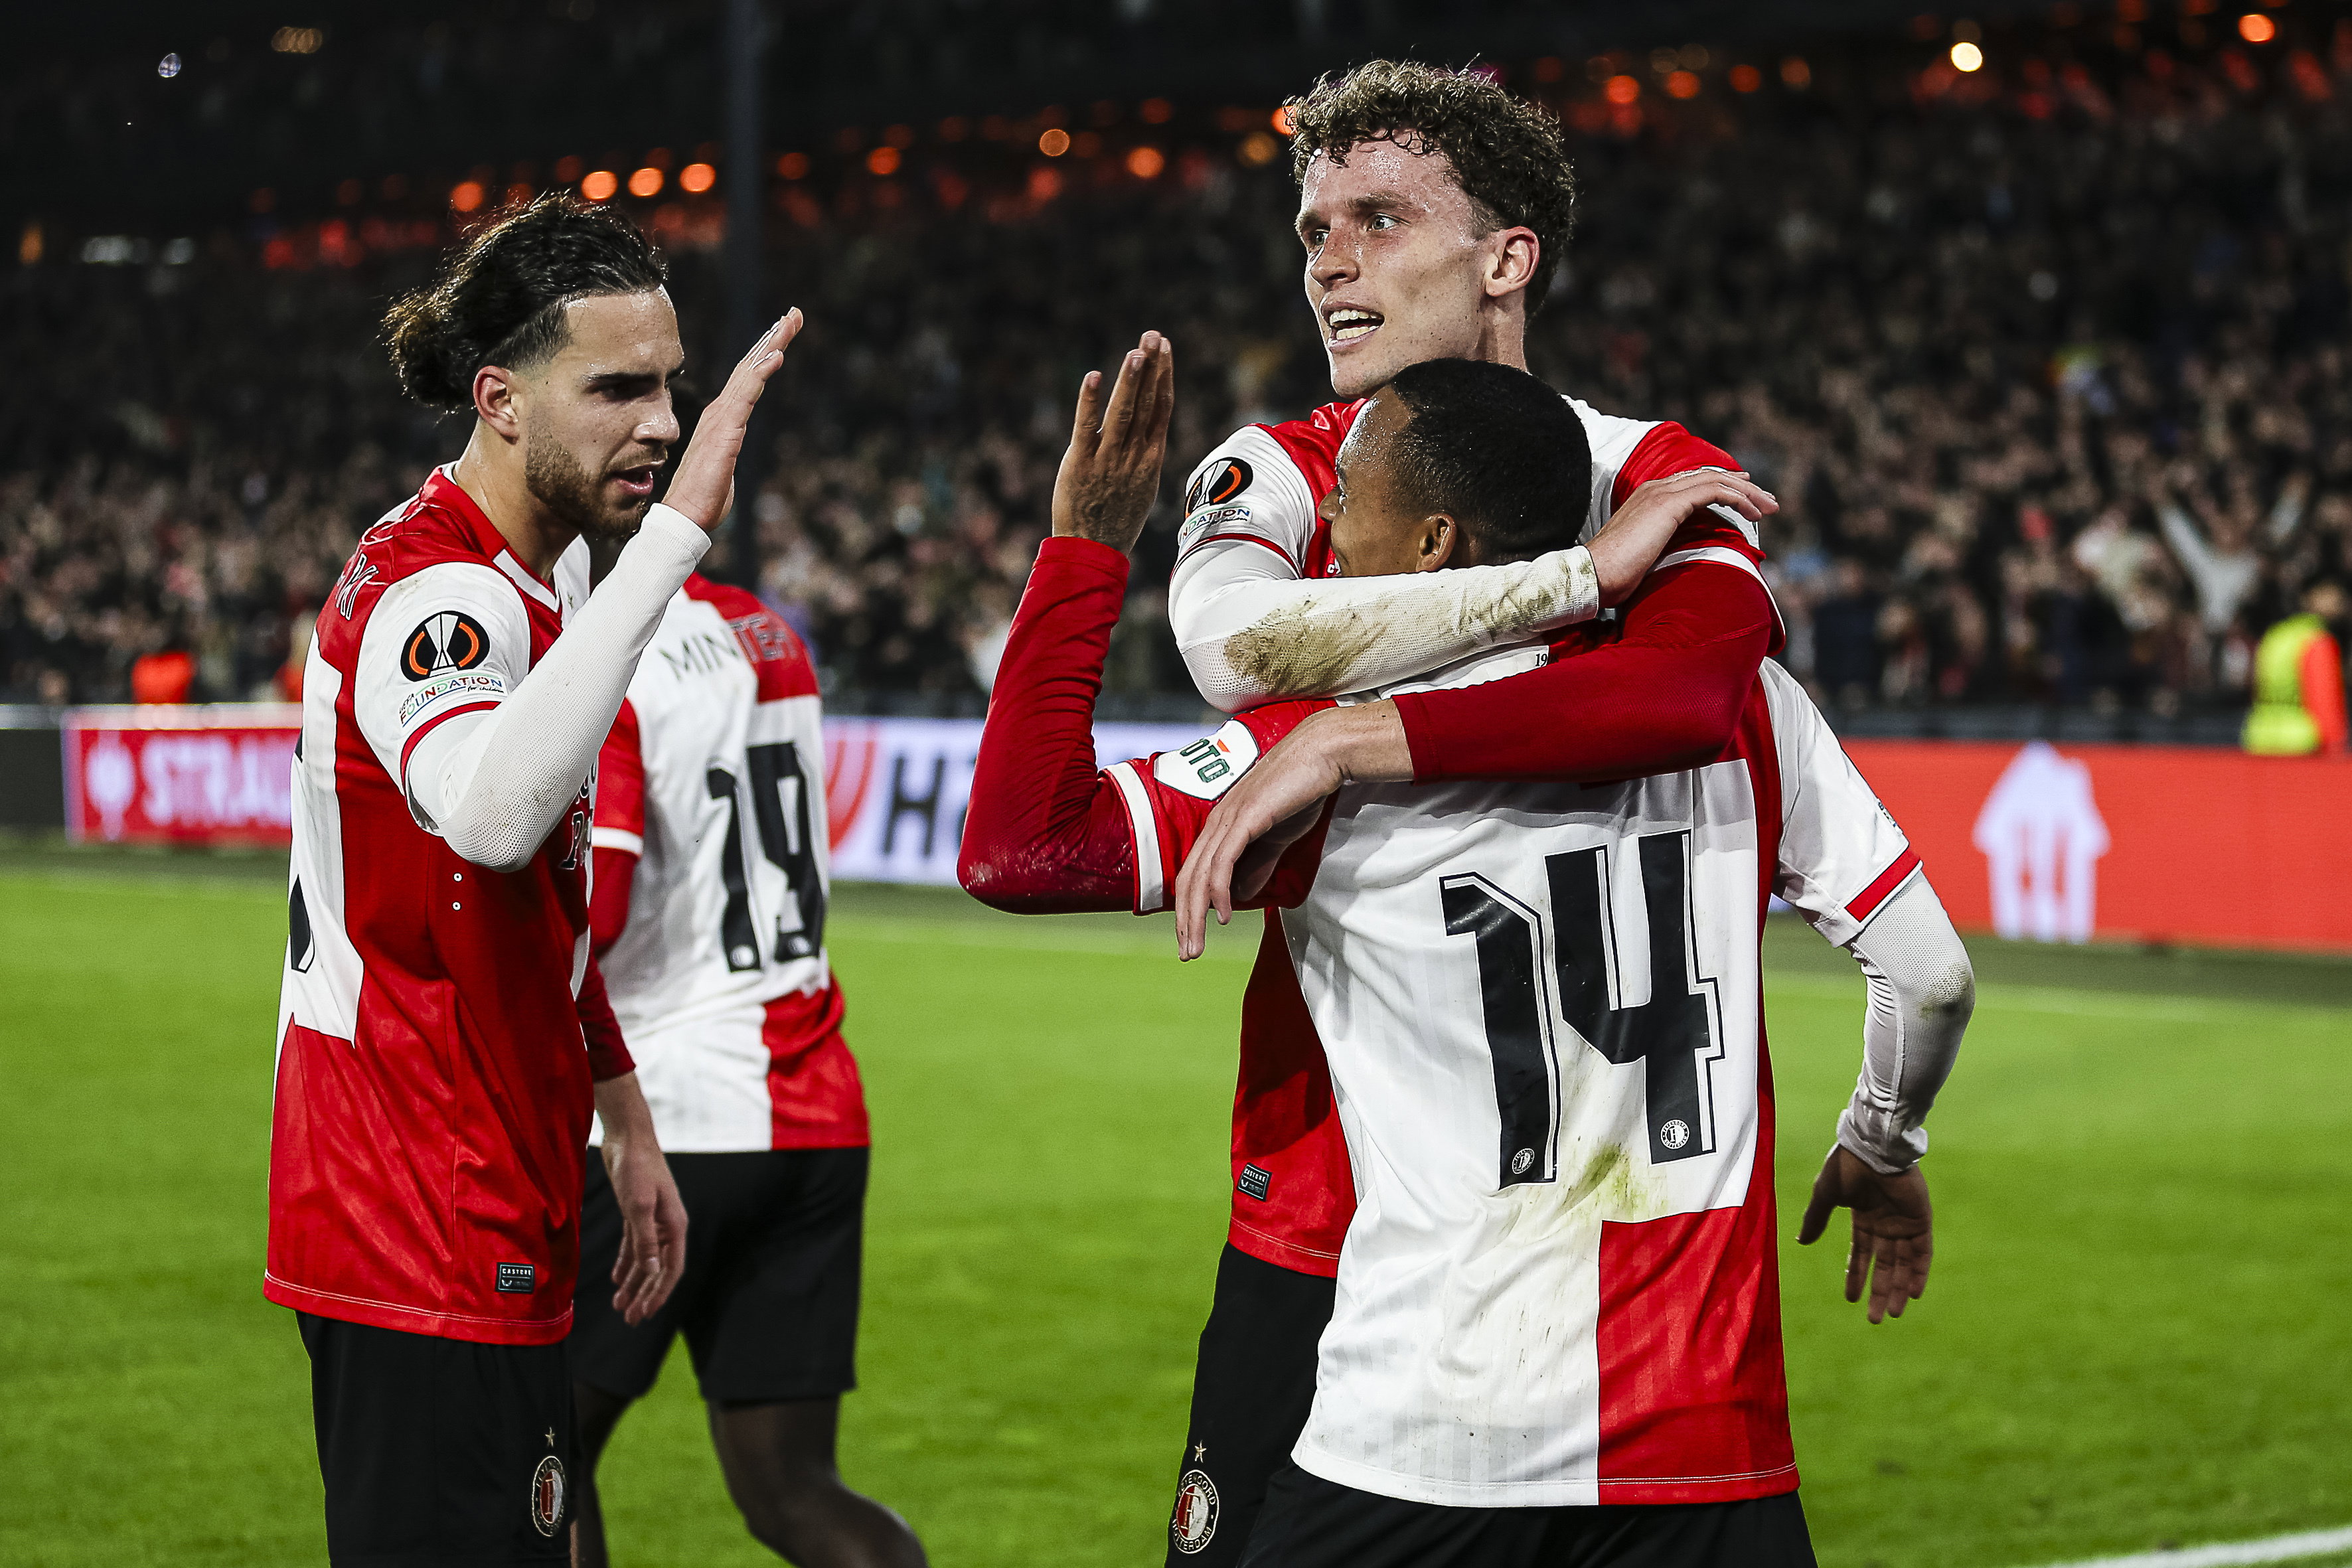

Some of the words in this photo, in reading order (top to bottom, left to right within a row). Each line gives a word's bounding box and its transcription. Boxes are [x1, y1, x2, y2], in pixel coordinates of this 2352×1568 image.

[400, 676, 503, 724] FOUNDATION
[705, 741, 823, 973] 19
[1438, 827, 1726, 1191] 14
